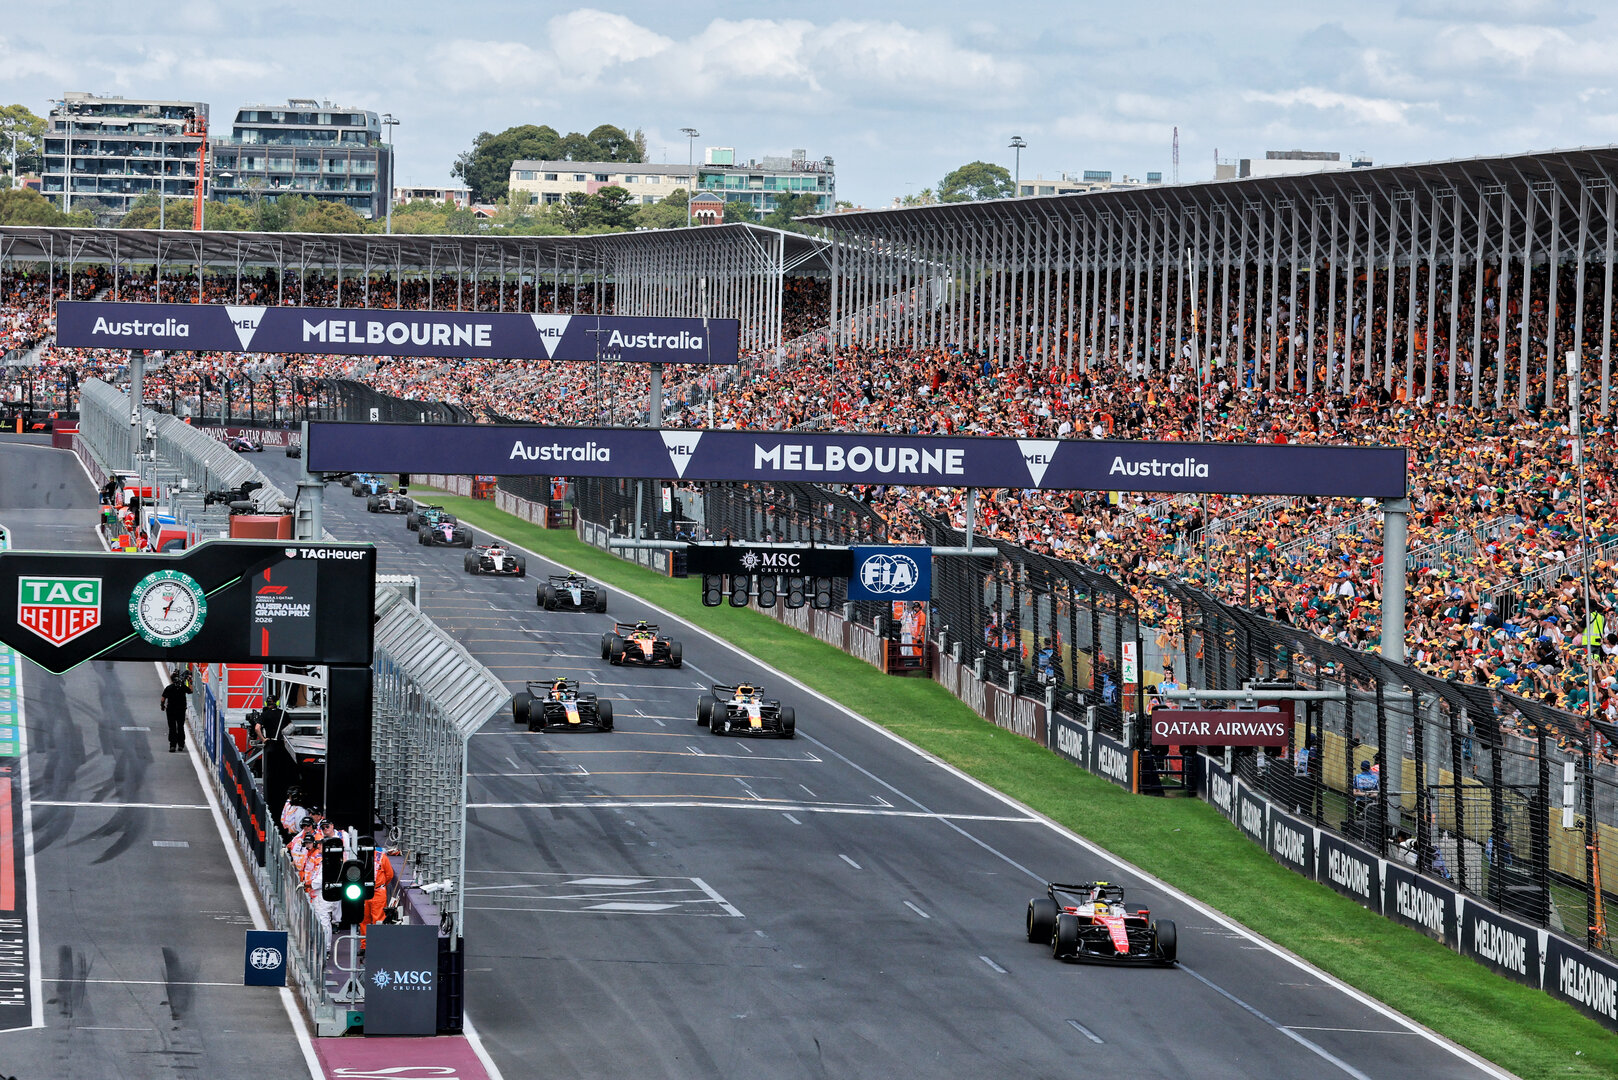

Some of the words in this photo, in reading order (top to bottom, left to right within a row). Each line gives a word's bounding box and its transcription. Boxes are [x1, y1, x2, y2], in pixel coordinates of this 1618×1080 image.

[92, 317, 189, 337] Australia
[233, 320, 257, 330] MEL
[302, 319, 492, 348] MELBOURNE
[538, 327, 563, 338] MEL
[608, 329, 702, 350] Australia
[510, 440, 610, 462] Australia
[667, 445, 693, 456] MEL
[754, 443, 965, 475] MELBOURNE
[1024, 455, 1050, 464] MEL
[1109, 456, 1208, 478] Australia
[761, 553, 800, 567] MSC
[26, 582, 93, 603] TAG
[23, 608, 95, 641] HEUER
[1155, 721, 1211, 737] QATAR
[1215, 722, 1284, 736] AIRWAYS
[1328, 846, 1370, 898] MELBOURNE
[1396, 879, 1445, 934] MELBOURNE
[1474, 916, 1526, 975] MELBOURNE
[393, 970, 432, 984] MSC
[1559, 953, 1617, 1020] MELBOURNE
